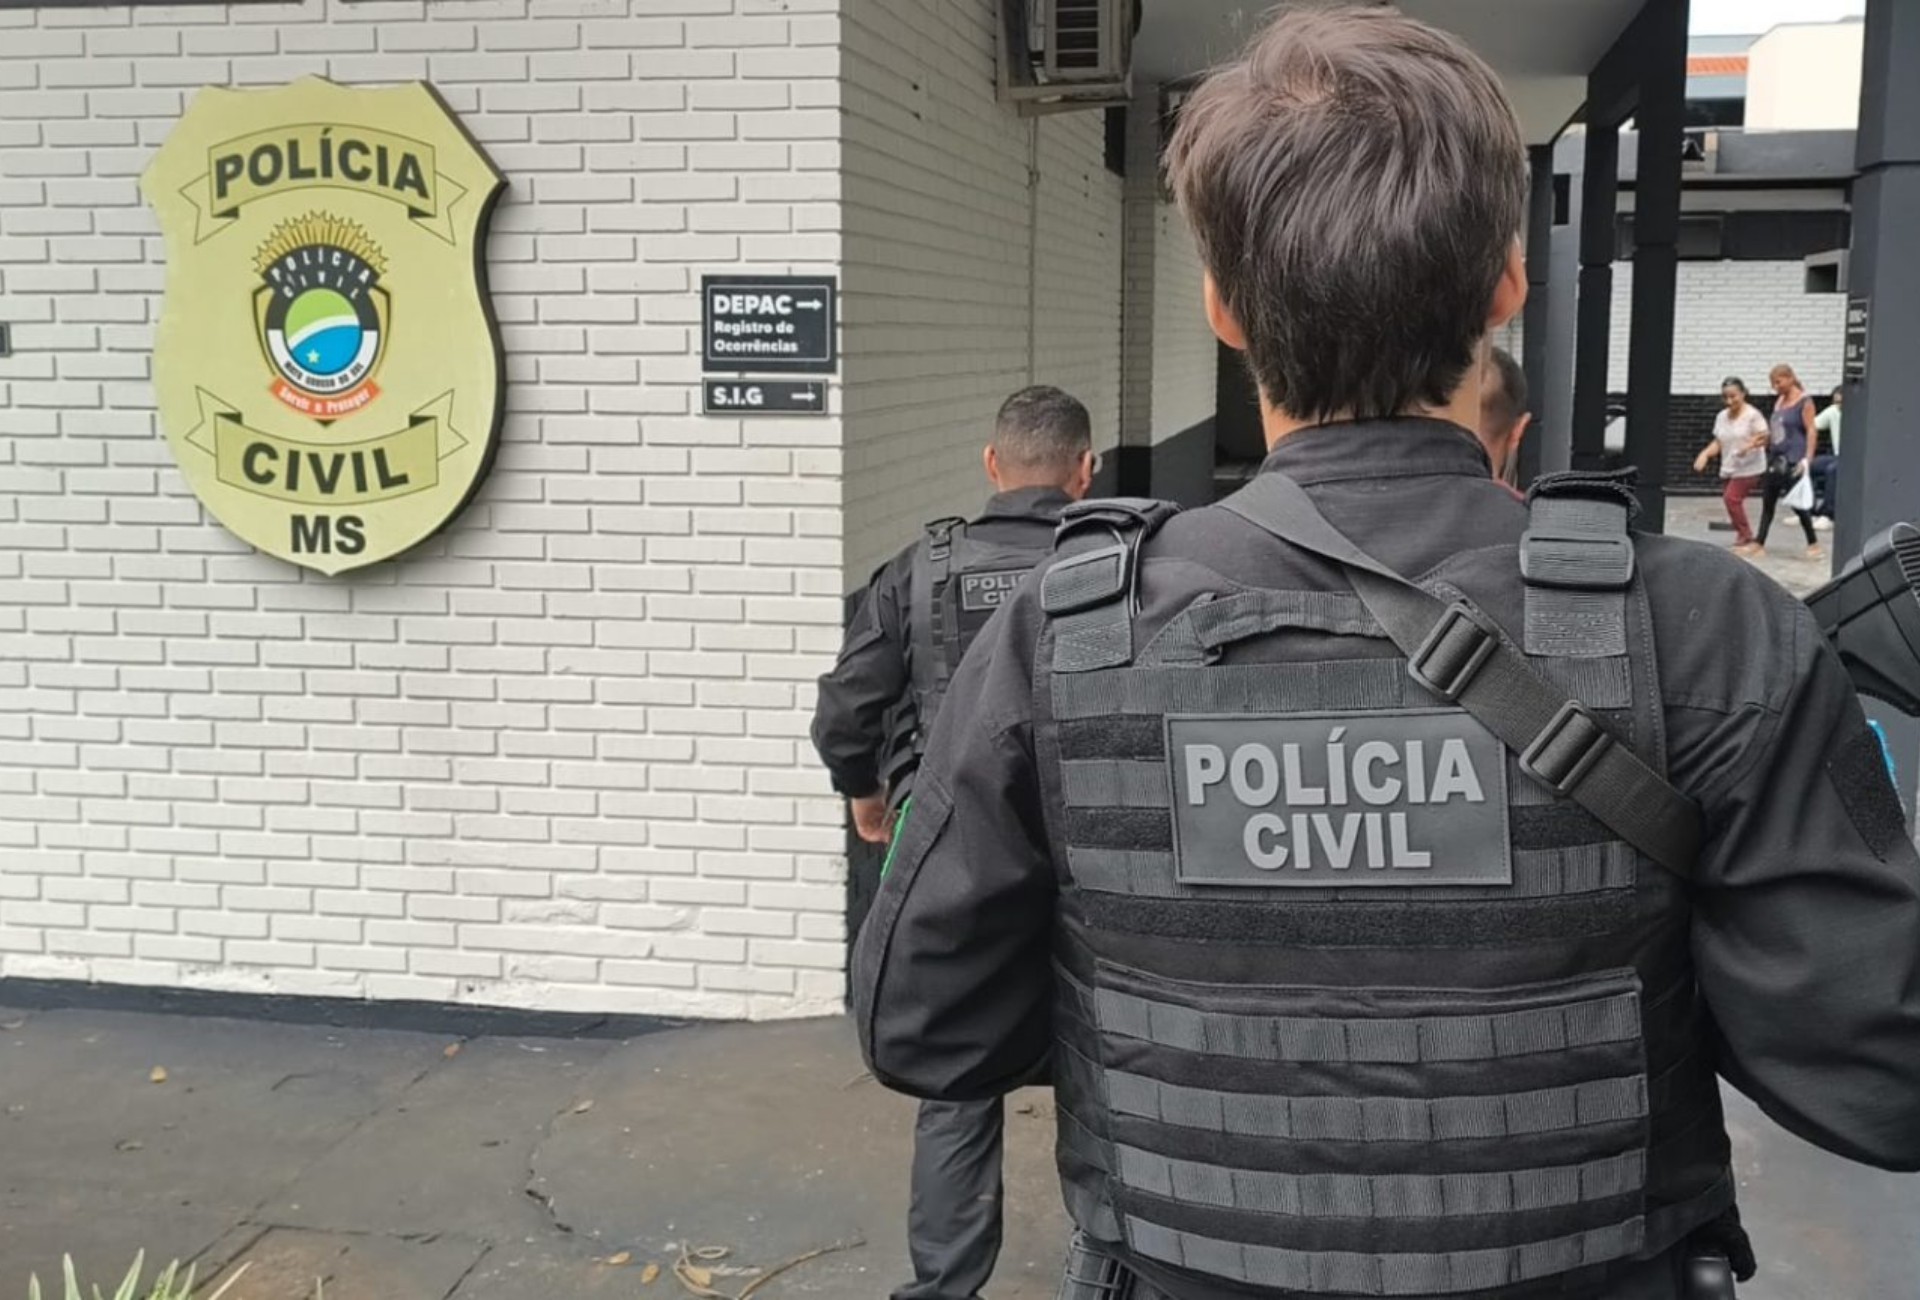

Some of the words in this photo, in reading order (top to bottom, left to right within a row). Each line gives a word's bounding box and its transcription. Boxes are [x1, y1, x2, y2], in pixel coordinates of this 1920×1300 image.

[214, 127, 430, 200] POLÍCIA
[713, 294, 793, 315] DEPAC
[714, 319, 773, 336] Registro
[775, 319, 795, 334] de
[714, 338, 799, 353] Ocorrências
[713, 386, 763, 405] S.I.G
[242, 441, 409, 495] CIVIL
[290, 514, 366, 555] MS
[1185, 726, 1485, 807] POLÍCIA
[1243, 811, 1432, 870] CIVIL
